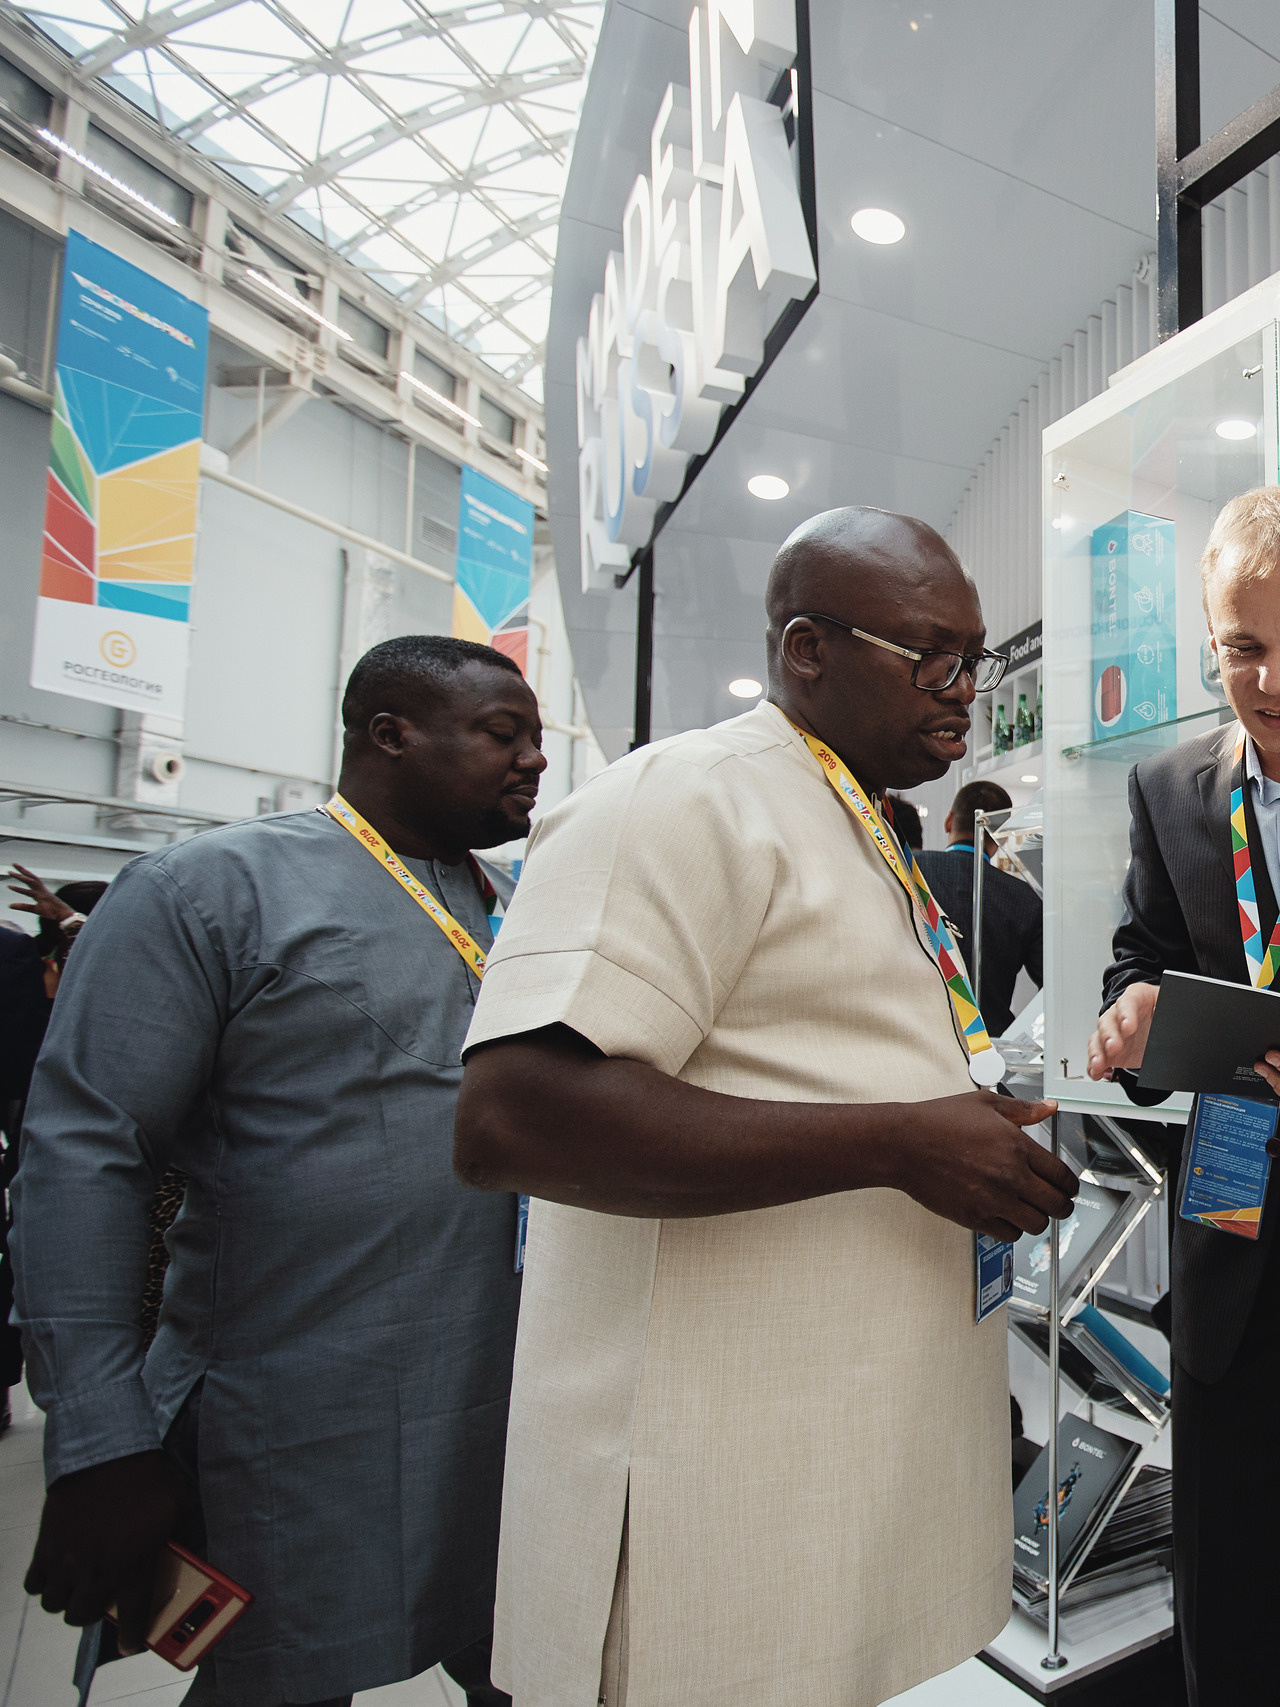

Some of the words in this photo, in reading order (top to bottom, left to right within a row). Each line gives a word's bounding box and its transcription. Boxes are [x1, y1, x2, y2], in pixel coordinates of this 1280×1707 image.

[578, 91, 774, 594] RUSSIA
[1108, 558, 1117, 638] BONTEL
[1009, 637, 1030, 664] Food
[818, 749, 837, 770] 2019
[840, 772, 898, 871] RUSSIA-AFRICA
[360, 829, 380, 847] 2019
[451, 929, 470, 949] 2019
[1075, 1197, 1101, 1210] BONTEL
[1078, 1441, 1104, 1459] BONTEL
